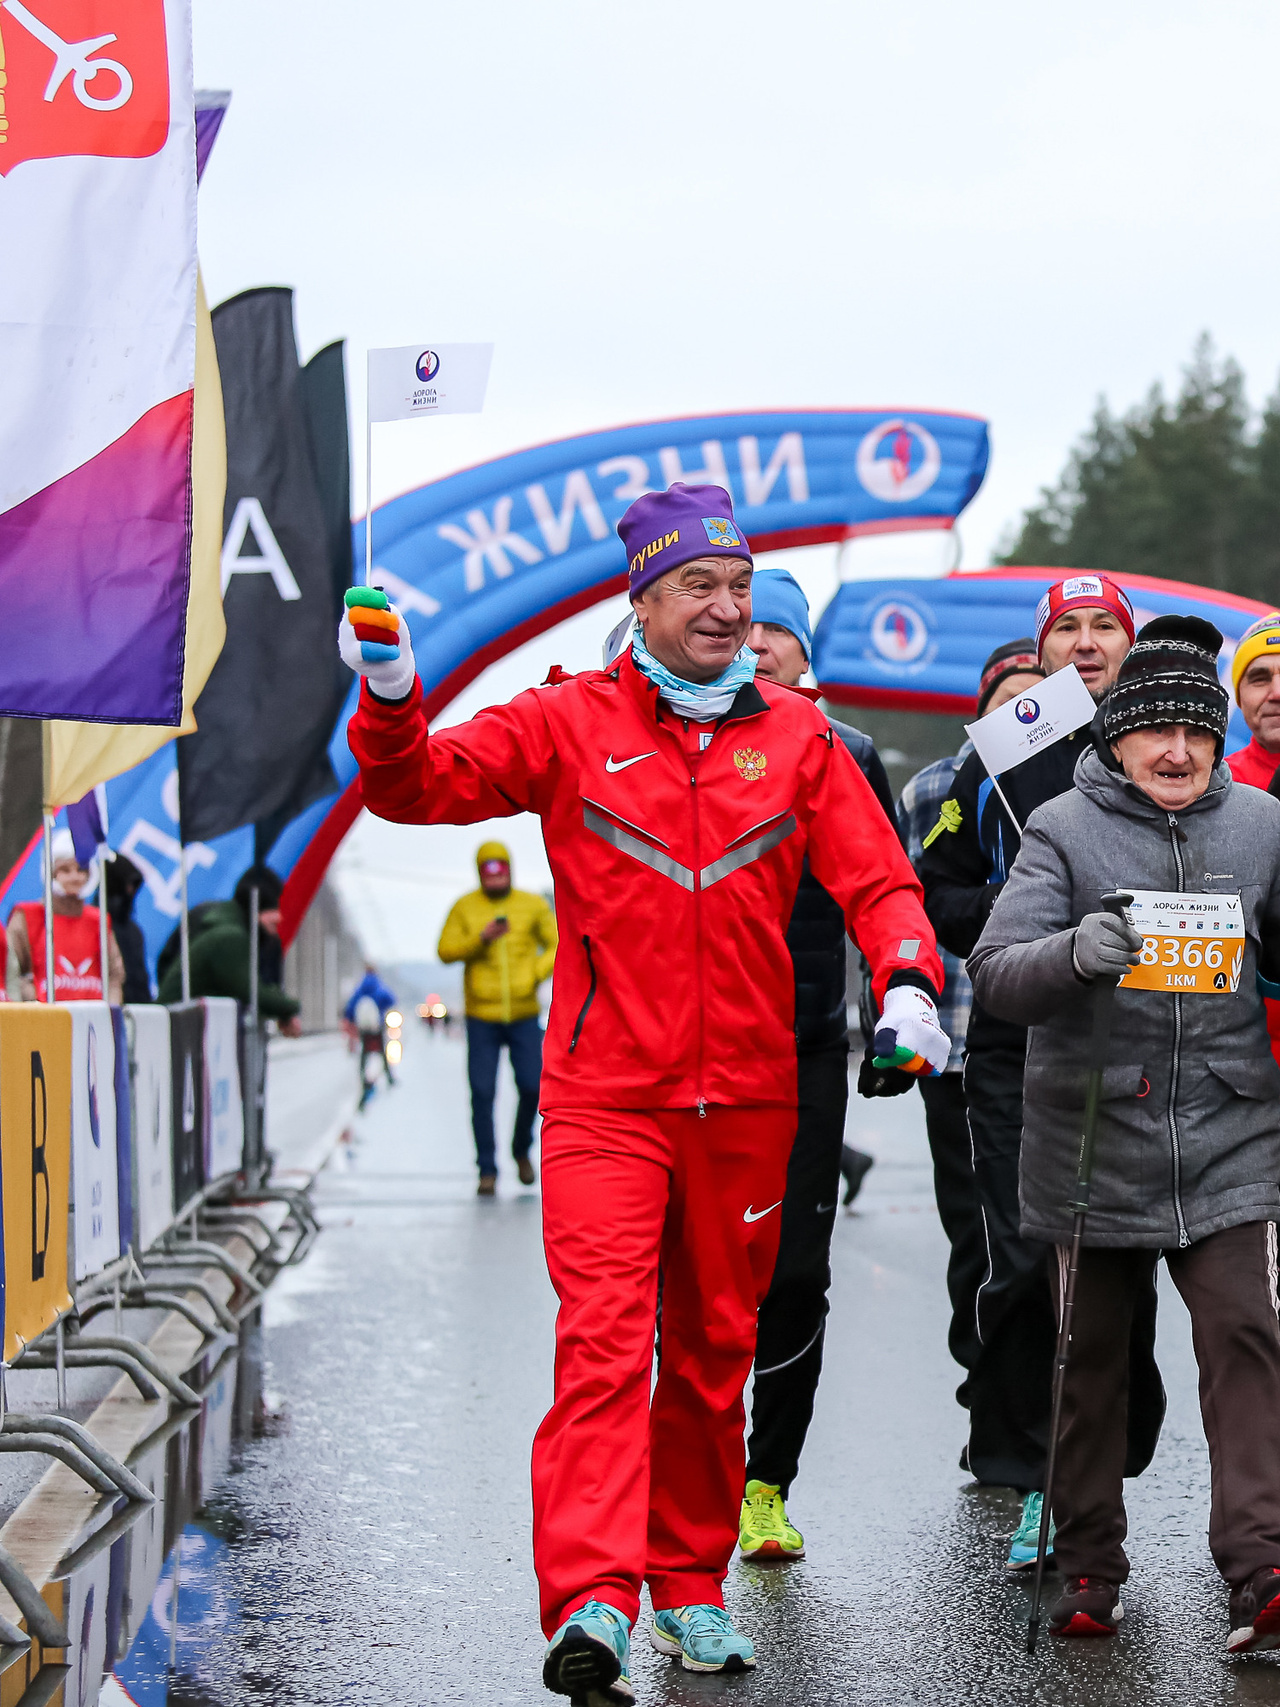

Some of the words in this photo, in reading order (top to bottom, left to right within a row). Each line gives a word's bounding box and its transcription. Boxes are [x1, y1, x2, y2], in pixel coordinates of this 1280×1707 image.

[412, 396, 437, 406] ЖИЗНИ
[413, 387, 437, 398] ДОРОГА
[438, 430, 811, 593] ЖИЗНИ
[1026, 721, 1051, 740] ДОРОГА
[1029, 726, 1055, 746] ЖИЗНИ
[1153, 902, 1185, 911] ДОРОГА
[1188, 903, 1220, 912] ЖИЗНИ
[1139, 936, 1224, 969] 8366
